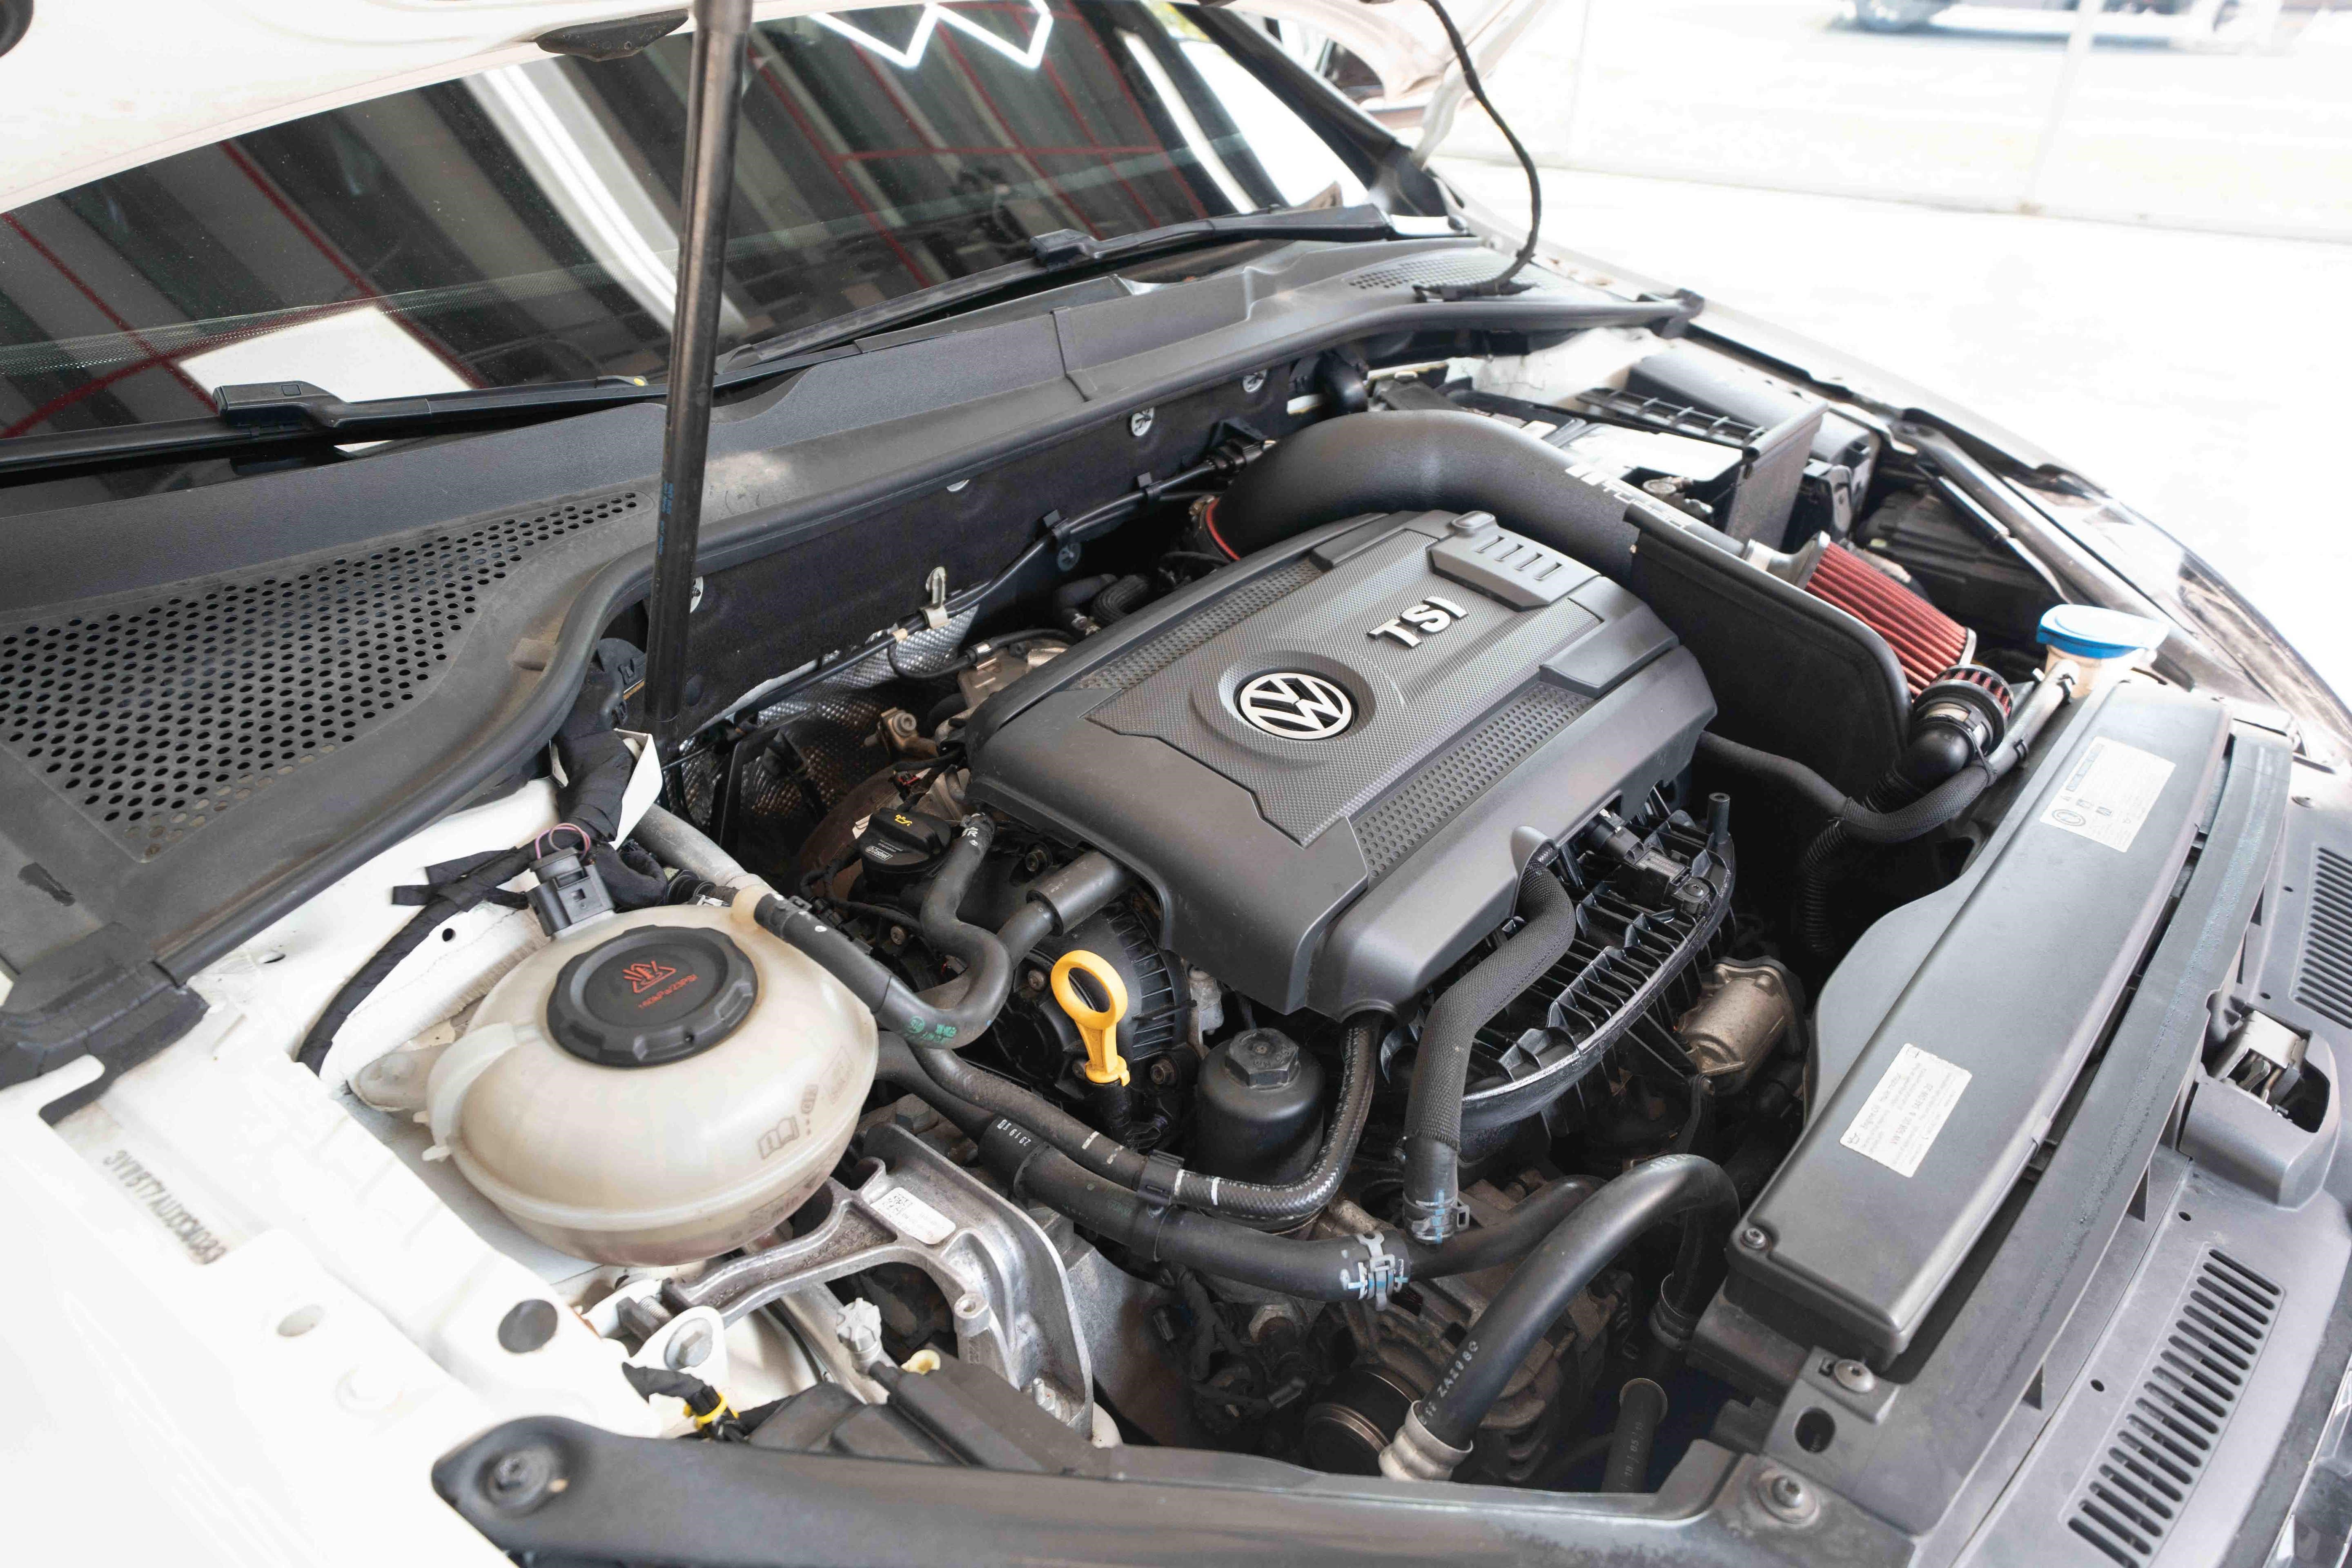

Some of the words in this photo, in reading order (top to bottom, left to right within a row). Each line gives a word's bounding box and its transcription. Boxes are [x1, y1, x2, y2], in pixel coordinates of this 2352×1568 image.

[1368, 596, 1468, 648] TSI
[1240, 673, 1352, 739] VW
[871, 847, 889, 859] Castrol
